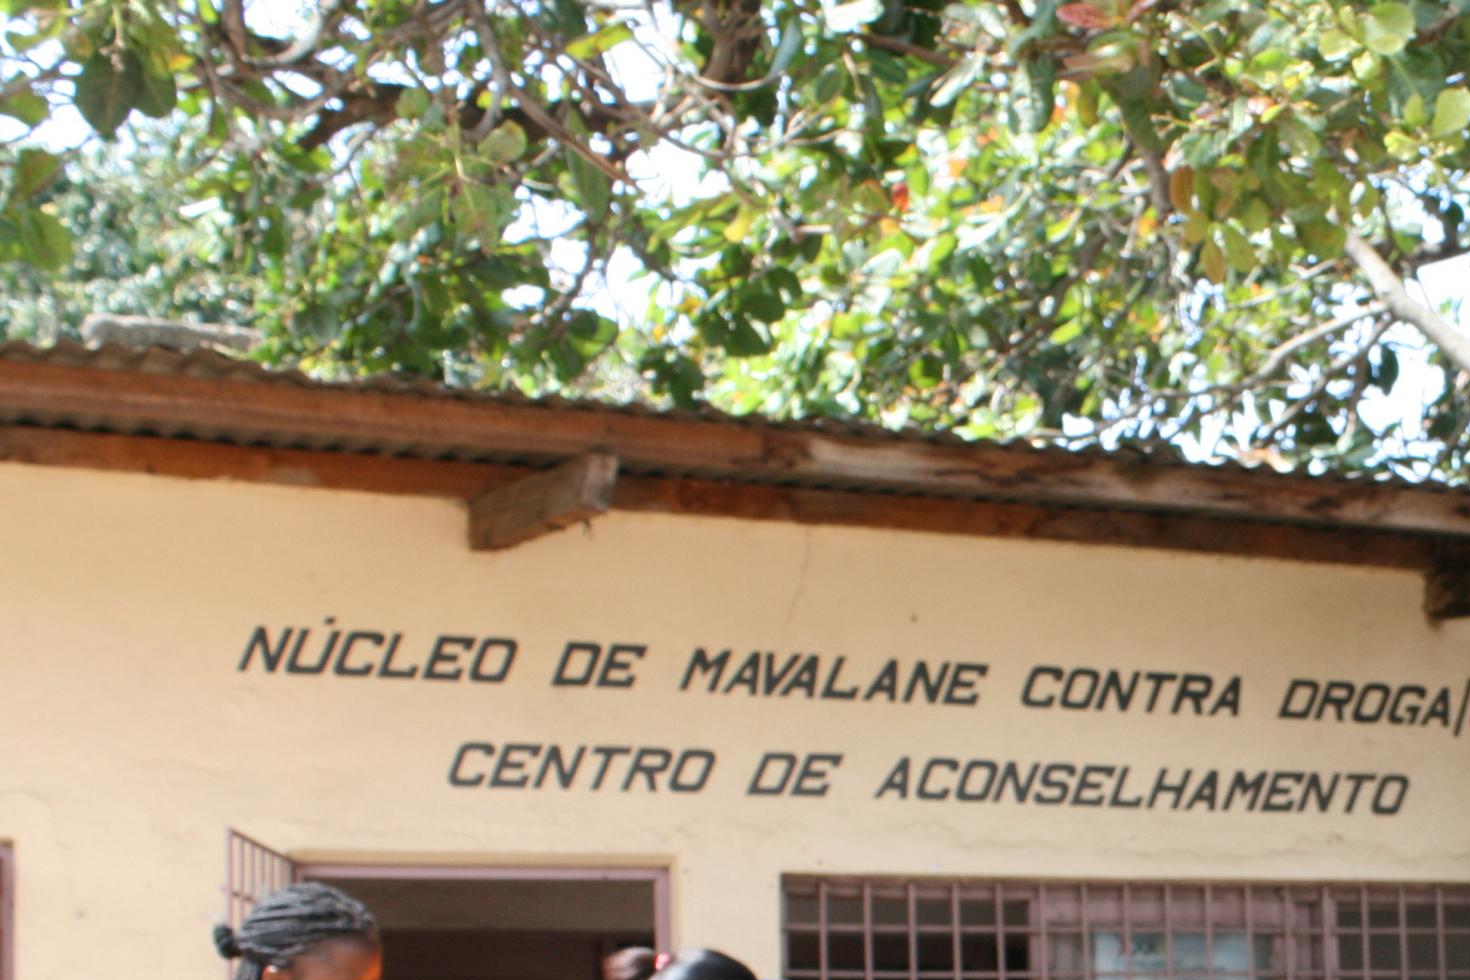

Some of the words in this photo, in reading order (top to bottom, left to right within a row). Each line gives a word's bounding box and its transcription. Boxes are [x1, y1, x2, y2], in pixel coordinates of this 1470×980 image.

[237, 615, 519, 684] NÚCLEO
[550, 641, 649, 689] DE
[679, 647, 988, 708] MAVALANE
[1020, 665, 1243, 717] CONTRA
[447, 741, 717, 794] CENTRO
[746, 752, 844, 798] DE
[874, 756, 1410, 817] ACONSELHAMENTO
